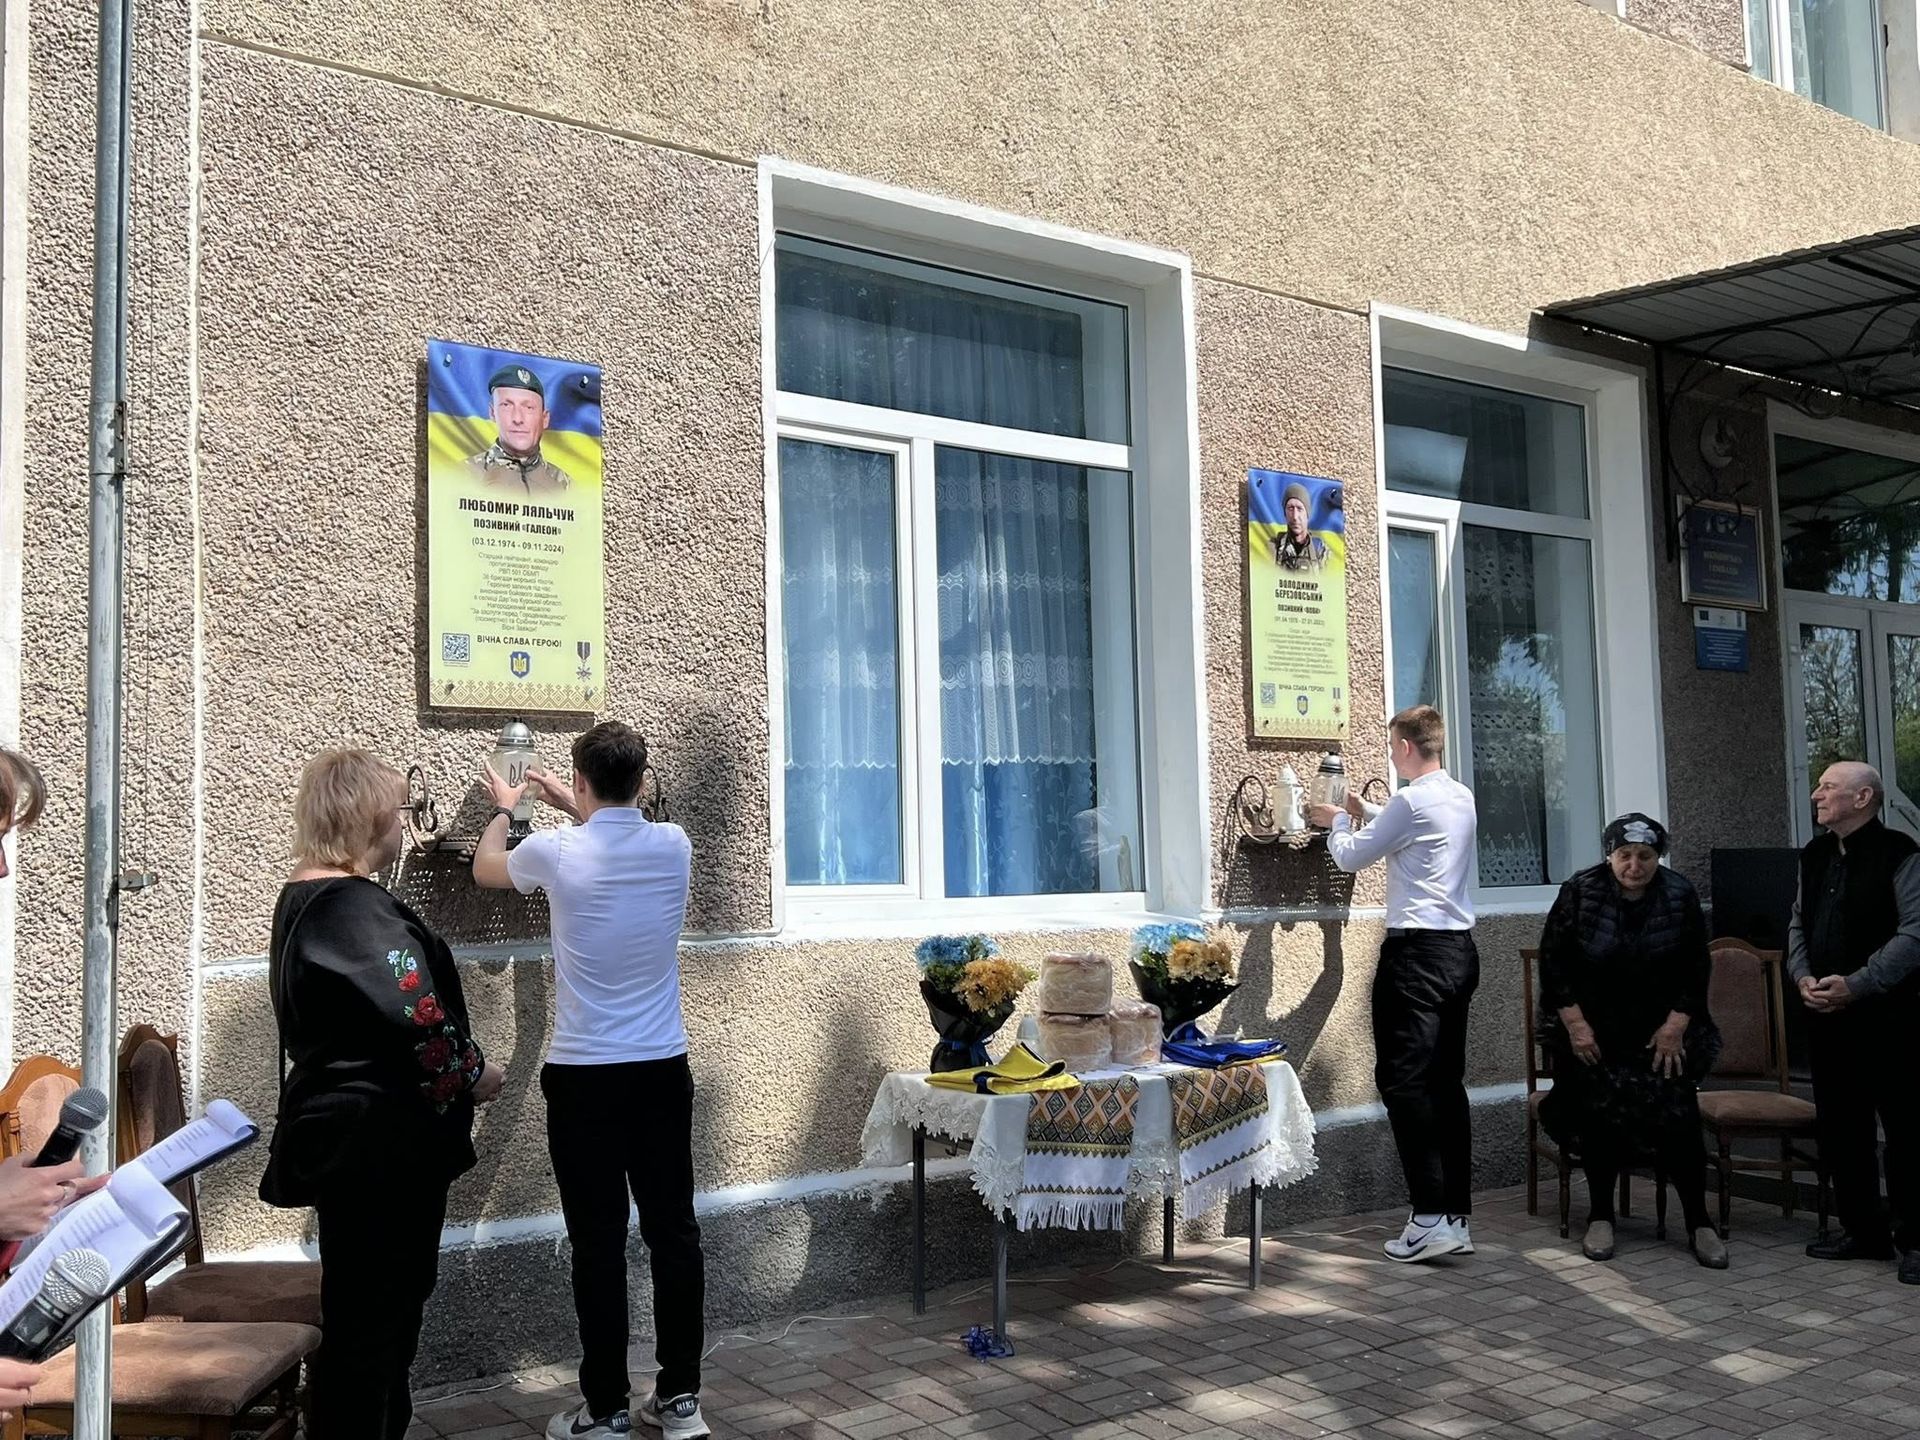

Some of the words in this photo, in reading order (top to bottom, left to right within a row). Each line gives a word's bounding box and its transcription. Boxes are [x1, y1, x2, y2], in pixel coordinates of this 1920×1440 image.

[459, 498, 519, 515] ЛЮБОМИР
[522, 505, 575, 521] ЛЯЛЬЧУК
[474, 518, 520, 532] ПОЗИВНИЙ
[472, 537, 516, 548] (03.12.1974
[522, 542, 564, 553] 09.11.2024)
[477, 635, 501, 643] ВІЧНА
[503, 637, 530, 645] СЛАВА
[676, 1400, 695, 1412] NIKE
